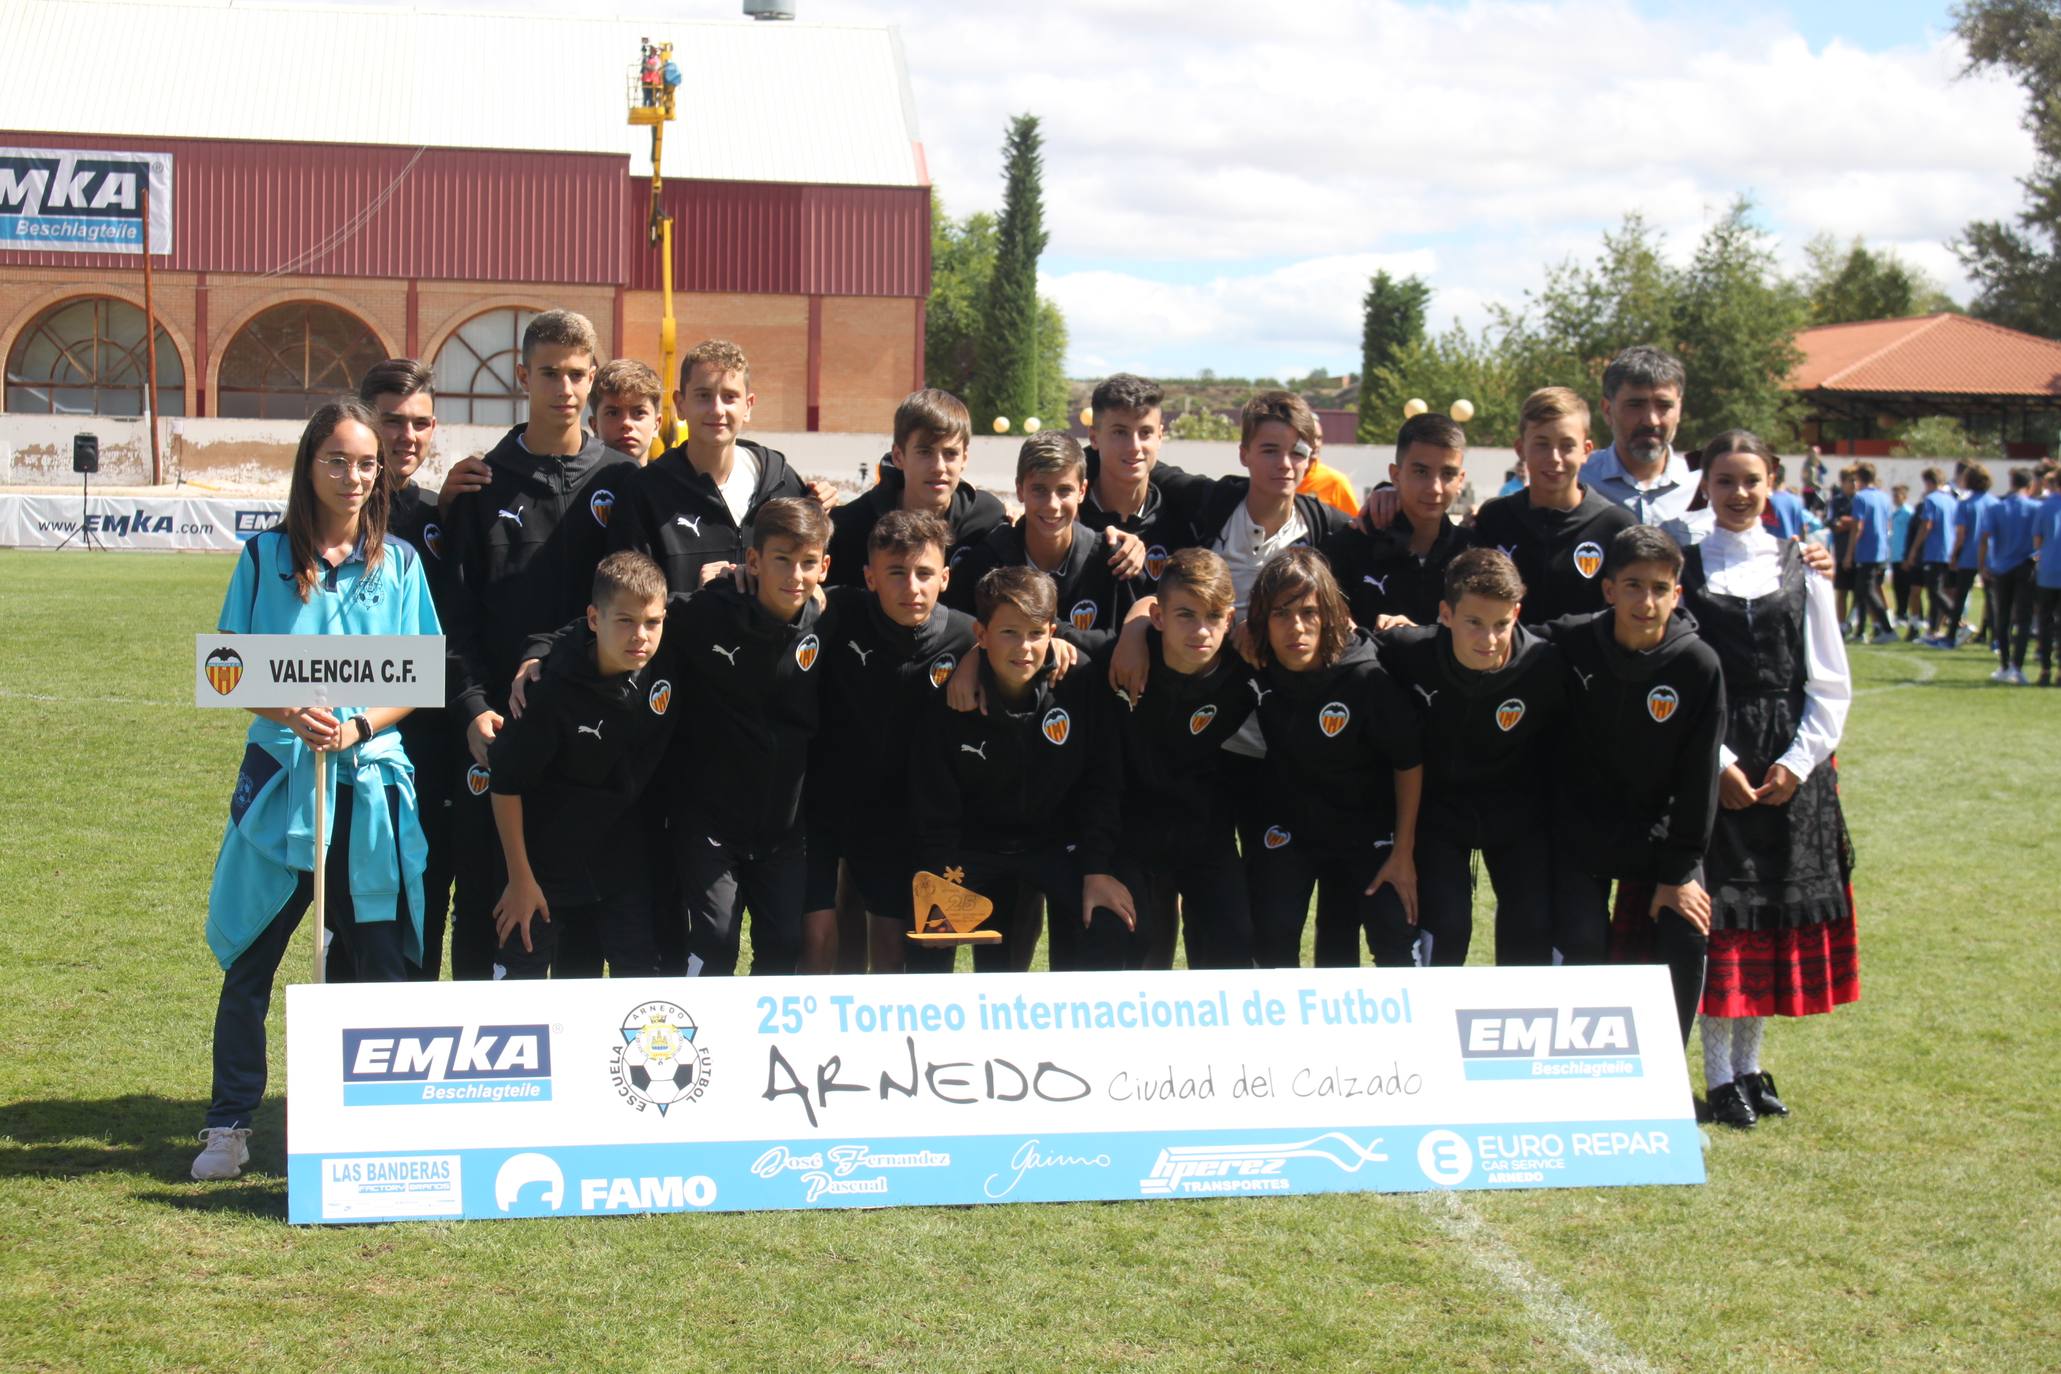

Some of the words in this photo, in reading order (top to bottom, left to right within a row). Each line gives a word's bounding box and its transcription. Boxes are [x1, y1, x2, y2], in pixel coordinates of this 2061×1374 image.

[0, 158, 137, 216] MKA
[15, 219, 138, 241] Beschlagteile
[238, 513, 288, 530] EM
[269, 659, 375, 683] VALENCIA
[380, 660, 417, 683] C.F.
[631, 1005, 686, 1021] ARNEDO
[829, 994, 965, 1033] Torneo
[977, 990, 1230, 1031] internacional
[1242, 989, 1286, 1026] de
[1297, 987, 1413, 1025] Futbol
[1467, 1008, 1630, 1058] EMKA
[352, 1026, 539, 1081] EMKA
[1530, 1059, 1635, 1077] Beschlagteile
[609, 1045, 648, 1113] ESCUELA
[684, 1046, 713, 1104] FUTBOL
[761, 1035, 1092, 1128] ARNEDO
[1107, 1064, 1216, 1101] Ciudad
[1232, 1063, 1276, 1099] del
[1291, 1060, 1424, 1099] Calzado
[422, 1082, 541, 1101] Beschlagteile
[1477, 1134, 1564, 1160] EURO
[1572, 1131, 1671, 1156] REPAR
[332, 1163, 362, 1183] LAS
[366, 1159, 451, 1182] BANDERAS
[750, 1145, 823, 1179] José
[827, 1144, 950, 1176] Fernandez
[1481, 1160, 1509, 1171] CAR
[1511, 1158, 1566, 1170] SERVICE
[800, 1171, 888, 1202] Pascual
[1182, 1177, 1290, 1193] TRANSPORTES
[1488, 1171, 1544, 1183] ARNEDO
[581, 1175, 718, 1210] FAMO
